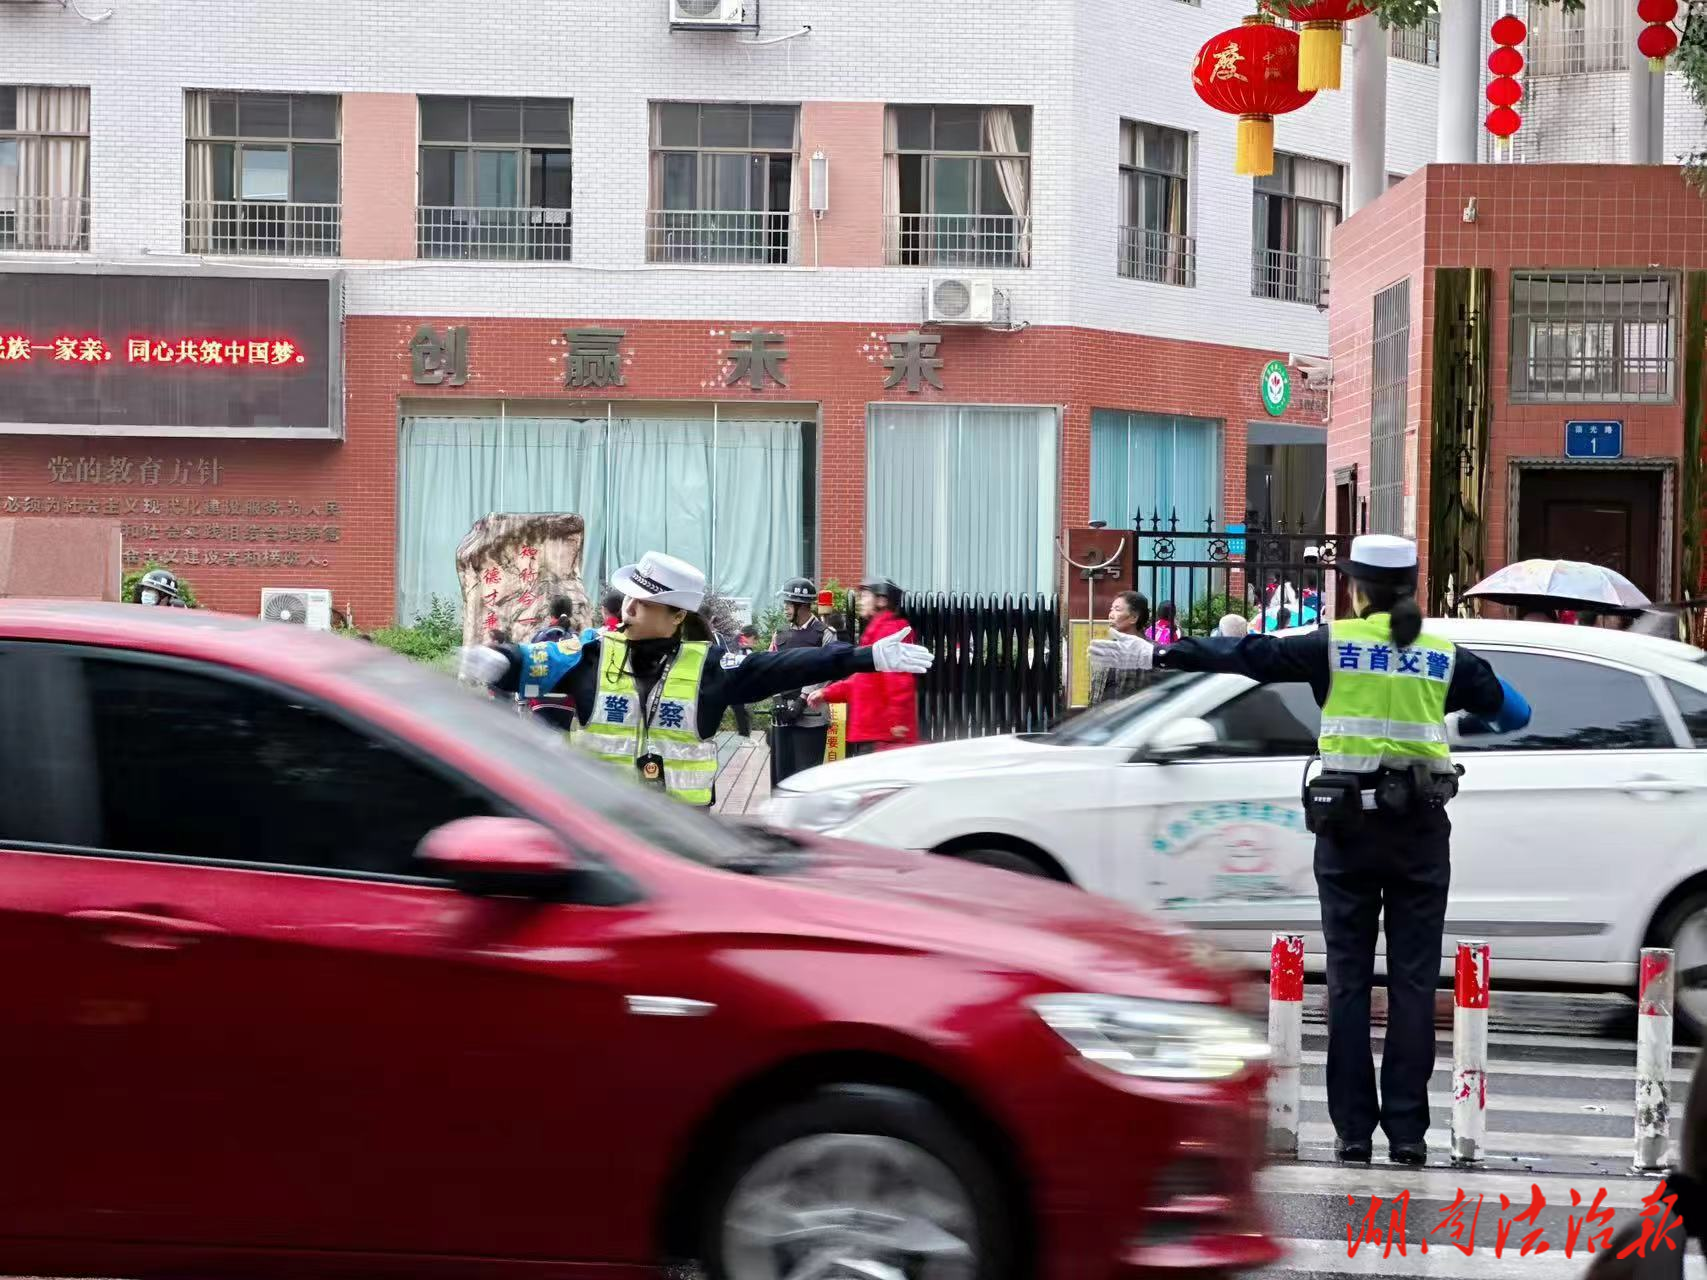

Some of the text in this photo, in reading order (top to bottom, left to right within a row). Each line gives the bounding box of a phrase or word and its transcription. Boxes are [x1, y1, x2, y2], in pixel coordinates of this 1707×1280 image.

[0, 336, 305, 364] 族一家亲,同心共筑中国梦。
[408, 323, 944, 393] 创赢未来
[1590, 437, 1597, 454] 1
[47, 456, 225, 485] 党的教育方针
[1337, 642, 1450, 680] 吉首交警
[604, 694, 685, 729] 警察
